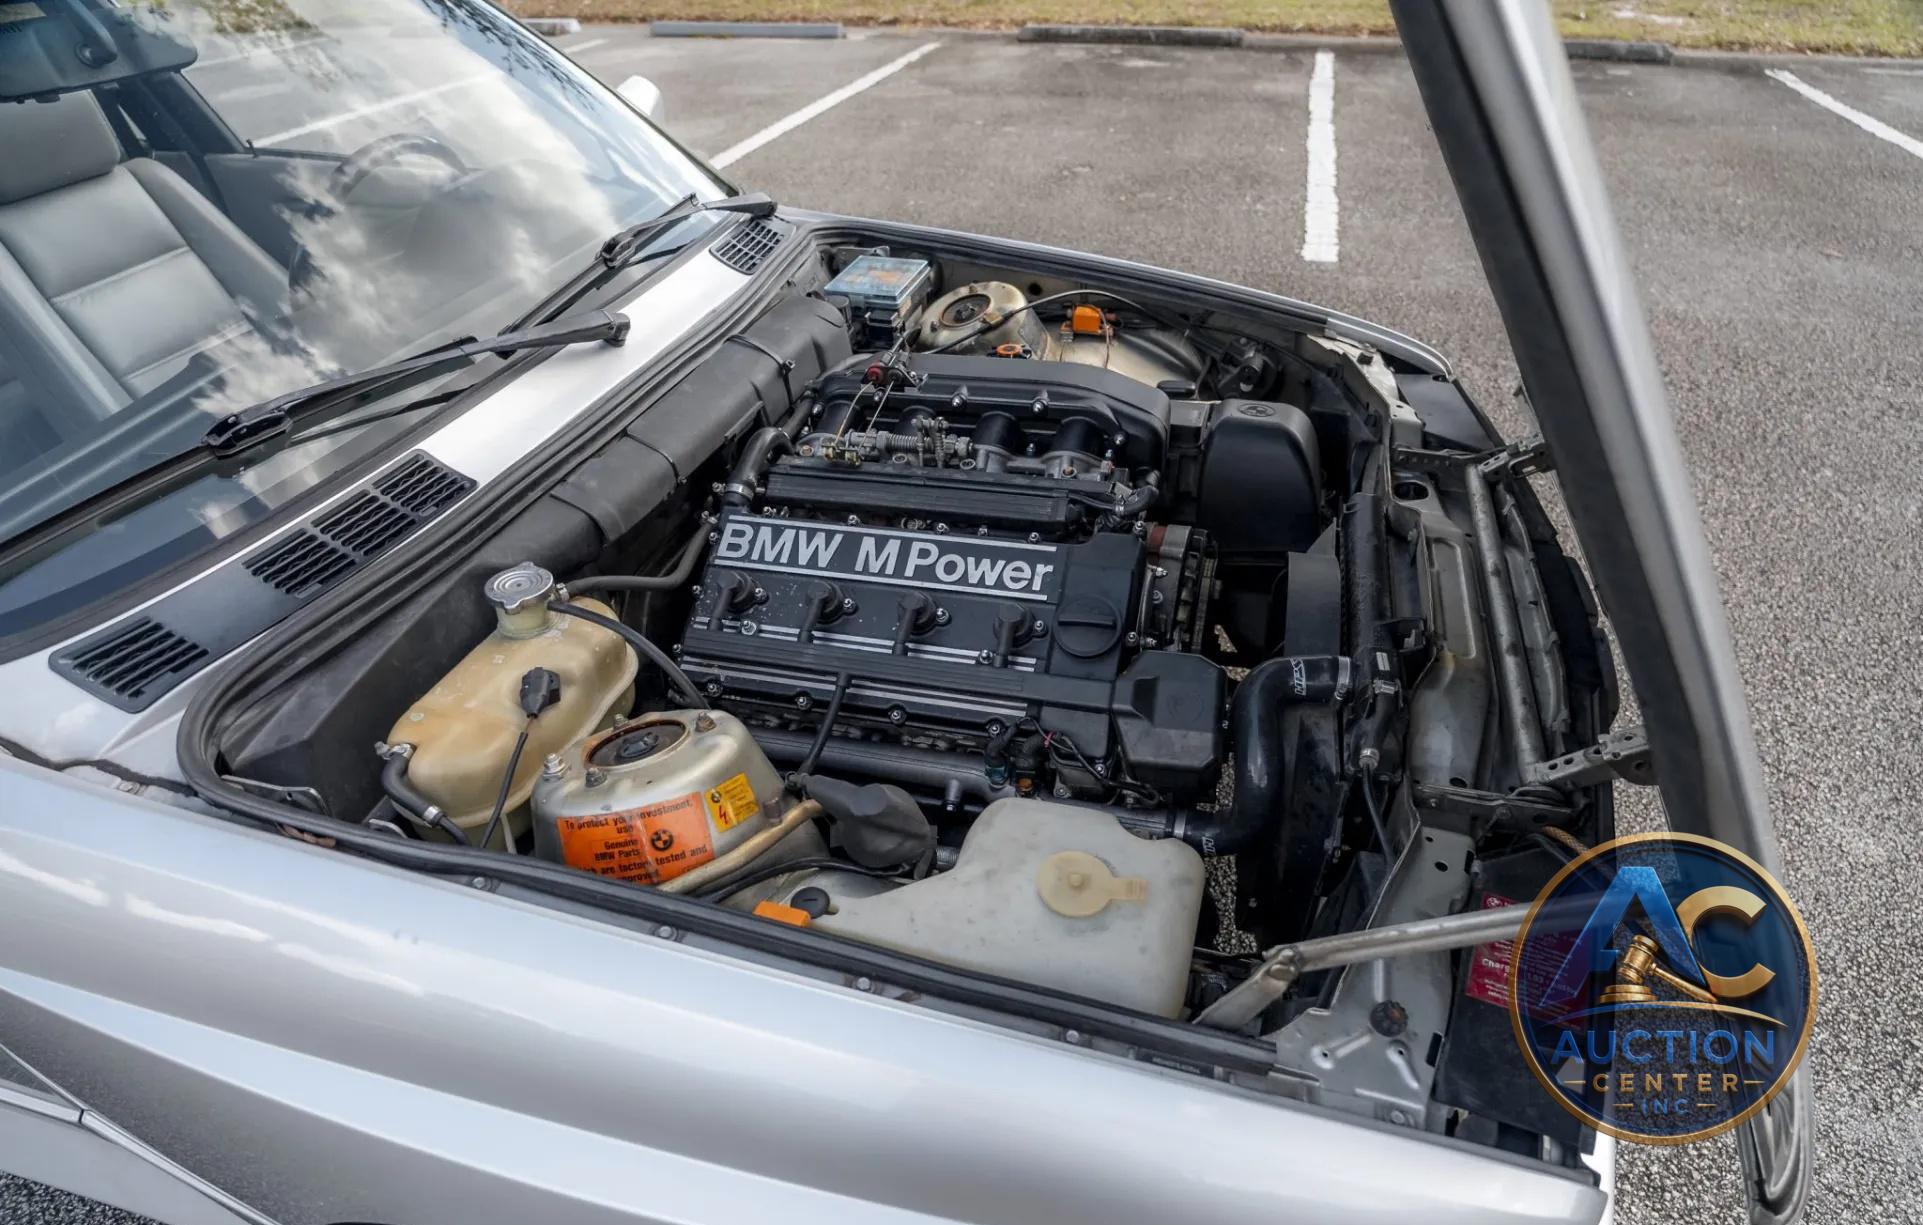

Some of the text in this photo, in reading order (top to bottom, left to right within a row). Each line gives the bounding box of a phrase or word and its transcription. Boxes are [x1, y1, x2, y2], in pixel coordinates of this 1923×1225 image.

[715, 523, 844, 568] BMW
[565, 820, 575, 831] To
[577, 816, 609, 831] protect
[594, 848, 641, 862] BMW Parts
[655, 850, 687, 866] tested
[690, 845, 708, 857] and
